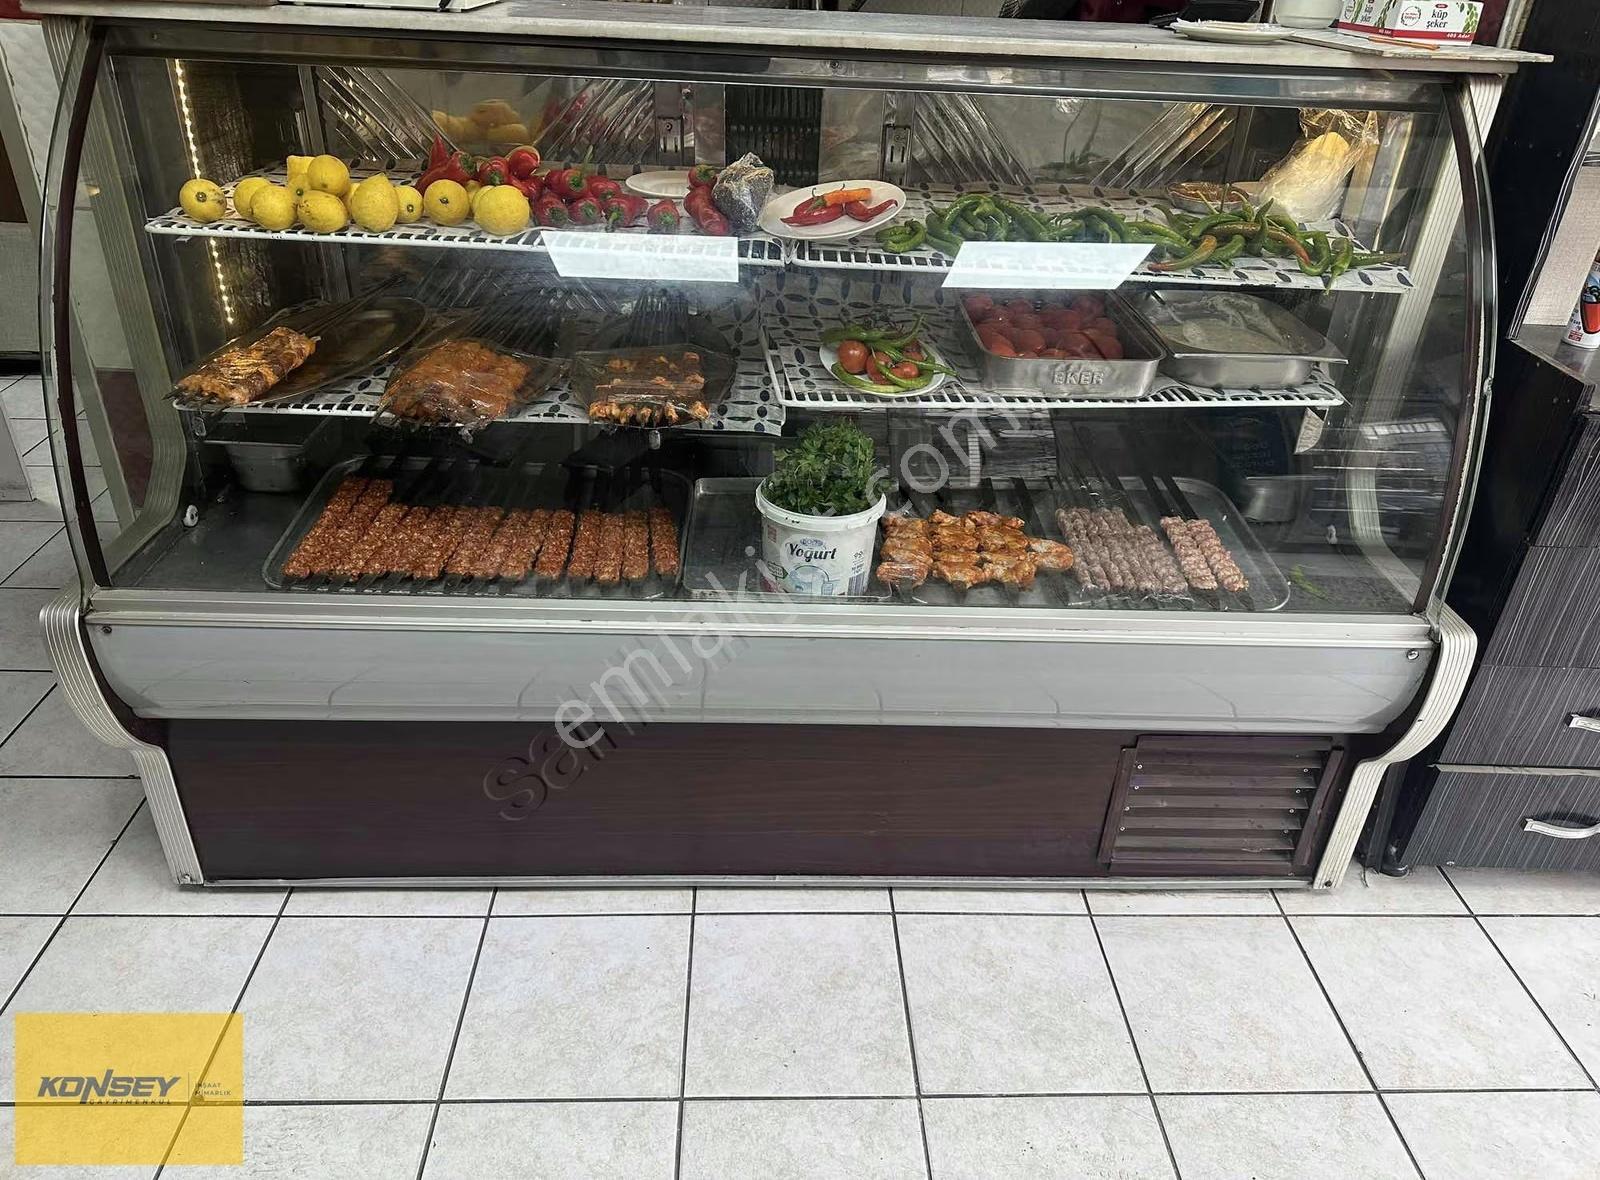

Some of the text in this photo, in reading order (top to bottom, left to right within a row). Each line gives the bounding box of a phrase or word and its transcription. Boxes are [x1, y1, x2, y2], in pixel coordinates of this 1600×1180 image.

[1431, 9, 1448, 20] küp
[1425, 20, 1448, 30] şeker
[788, 543, 838, 563] Yogurt
